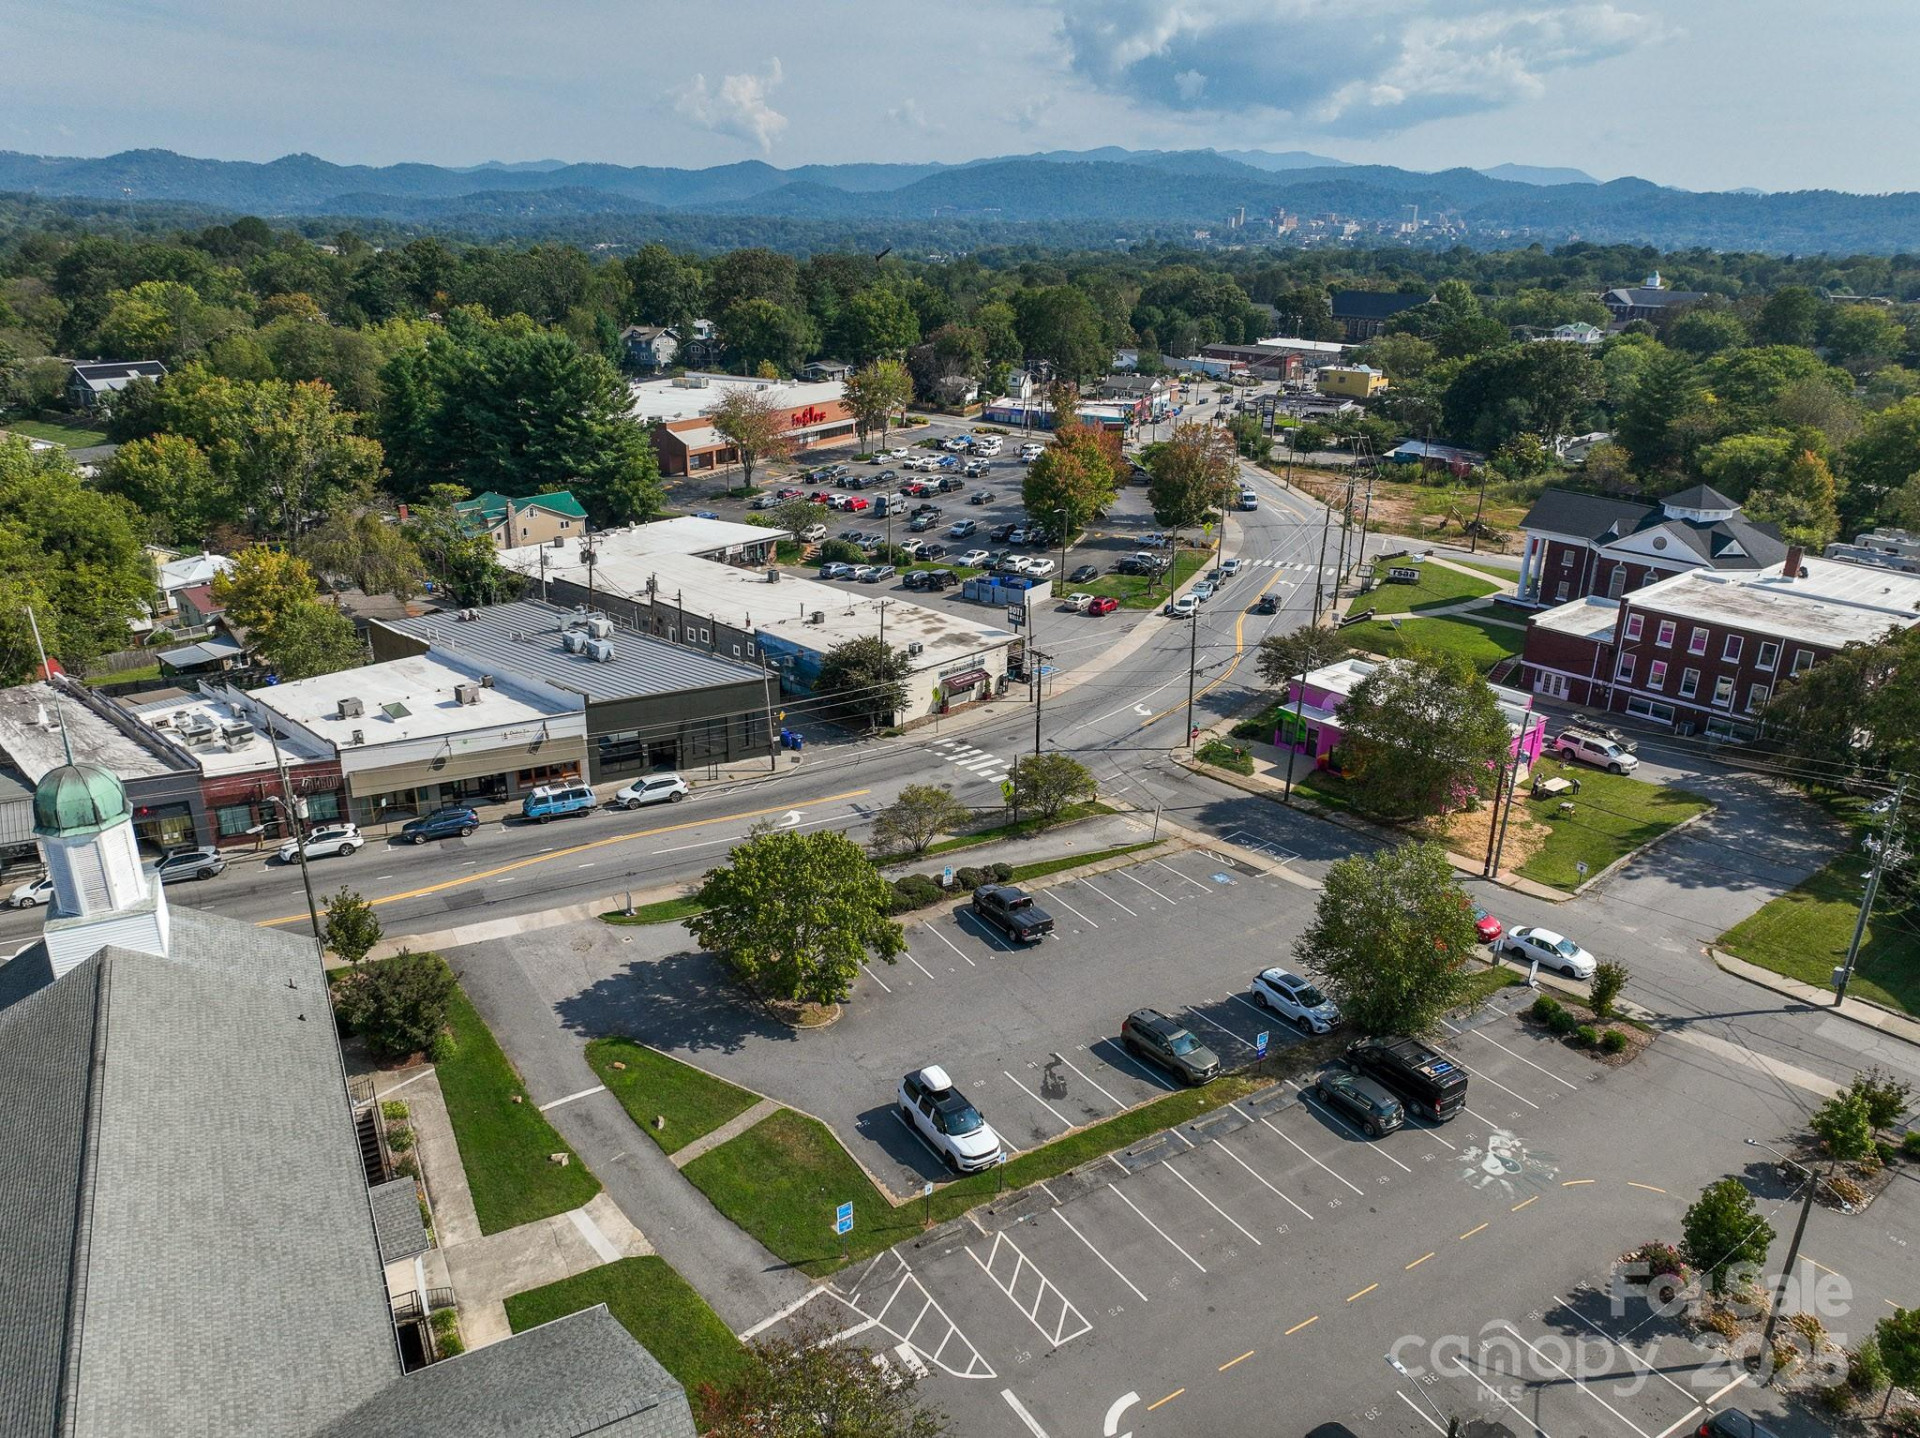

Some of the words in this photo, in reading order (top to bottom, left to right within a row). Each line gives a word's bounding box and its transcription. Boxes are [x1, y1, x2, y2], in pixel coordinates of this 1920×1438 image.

[1393, 569, 1416, 578] rsaa
[1008, 605, 1023, 617] BOTI
[1328, 1198, 1343, 1209] 28
[1276, 1223, 1291, 1234] 27
[1108, 1305, 1125, 1317] 24
[1014, 1351, 1031, 1365] 23
[1422, 1372, 1440, 1385] 38
[1364, 1406, 1383, 1421] 39
